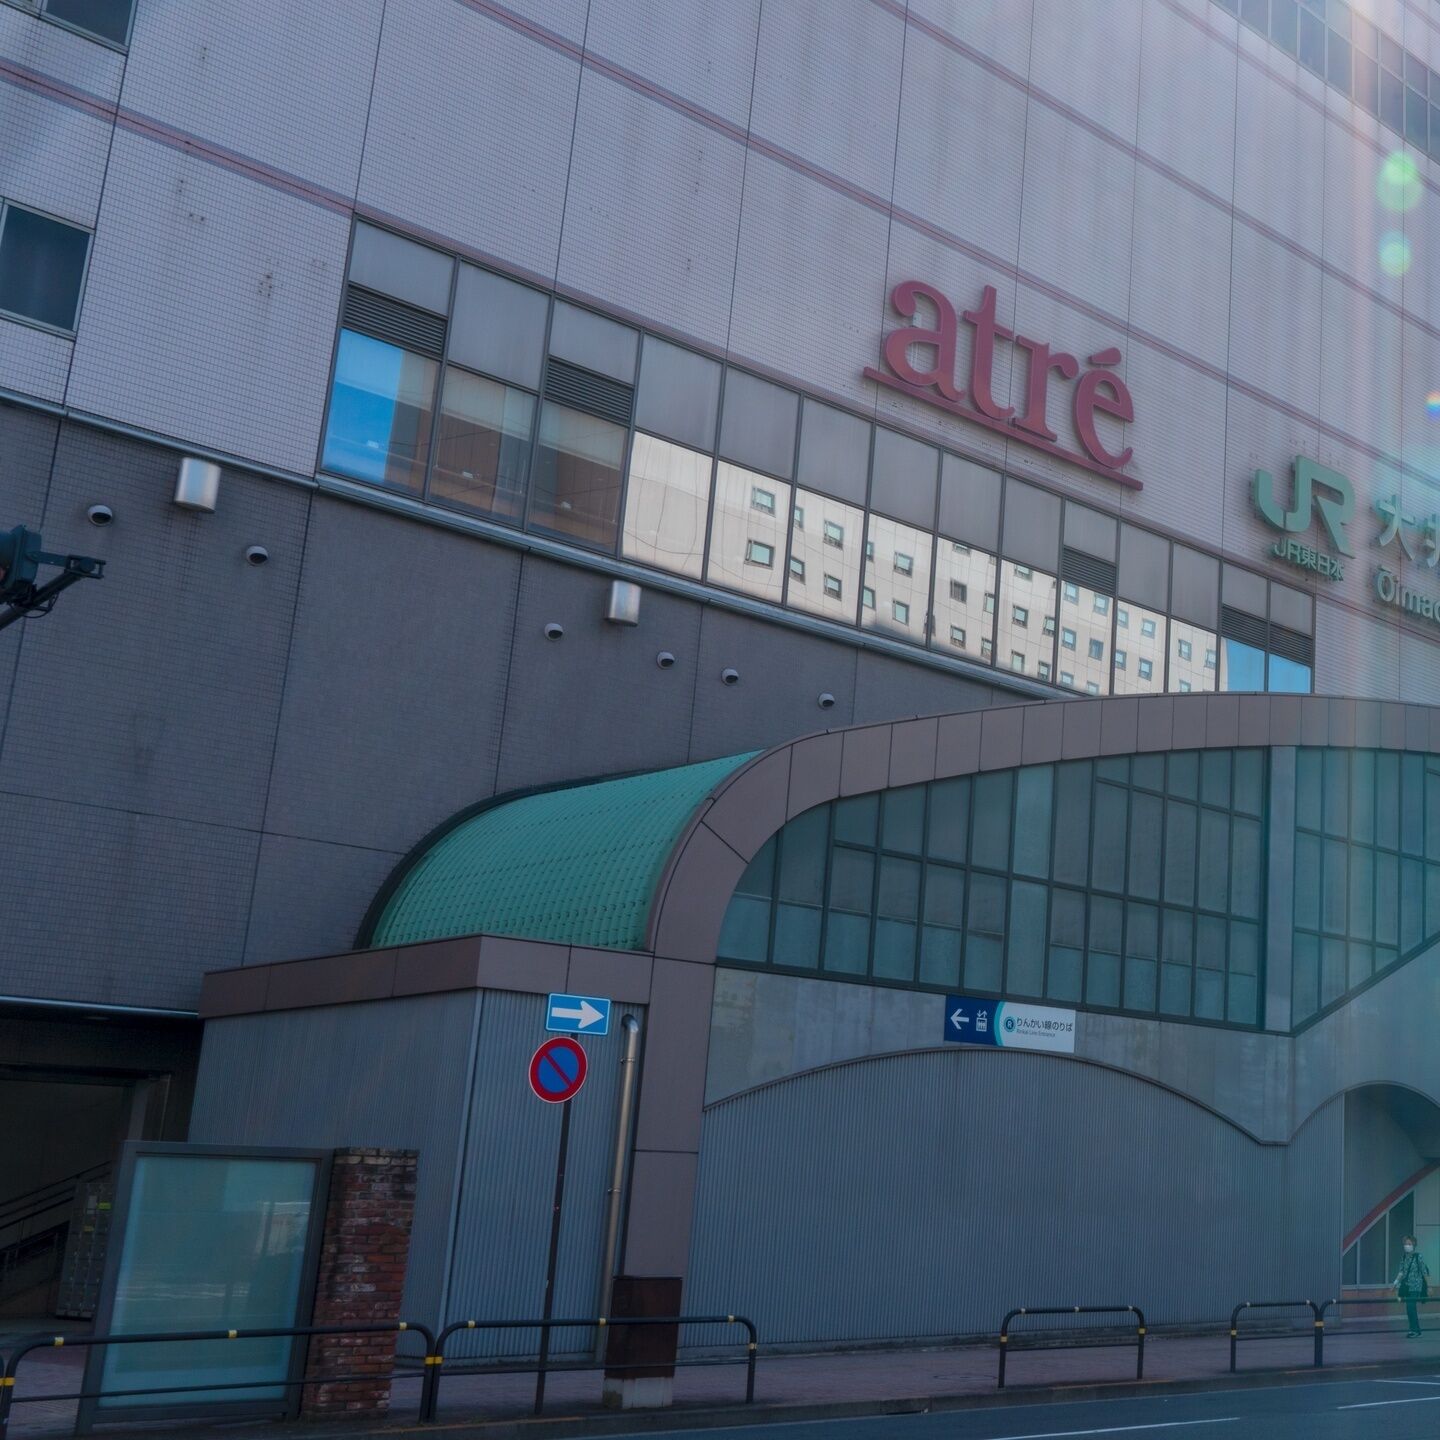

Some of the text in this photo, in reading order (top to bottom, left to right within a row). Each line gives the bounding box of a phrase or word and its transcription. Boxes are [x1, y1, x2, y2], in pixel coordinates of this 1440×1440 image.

[884, 279, 1135, 471] atré
[1254, 454, 1356, 560] JR
[1273, 537, 1344, 581] JR東日本
[1016, 1017, 1073, 1032] りんかい線のりば
